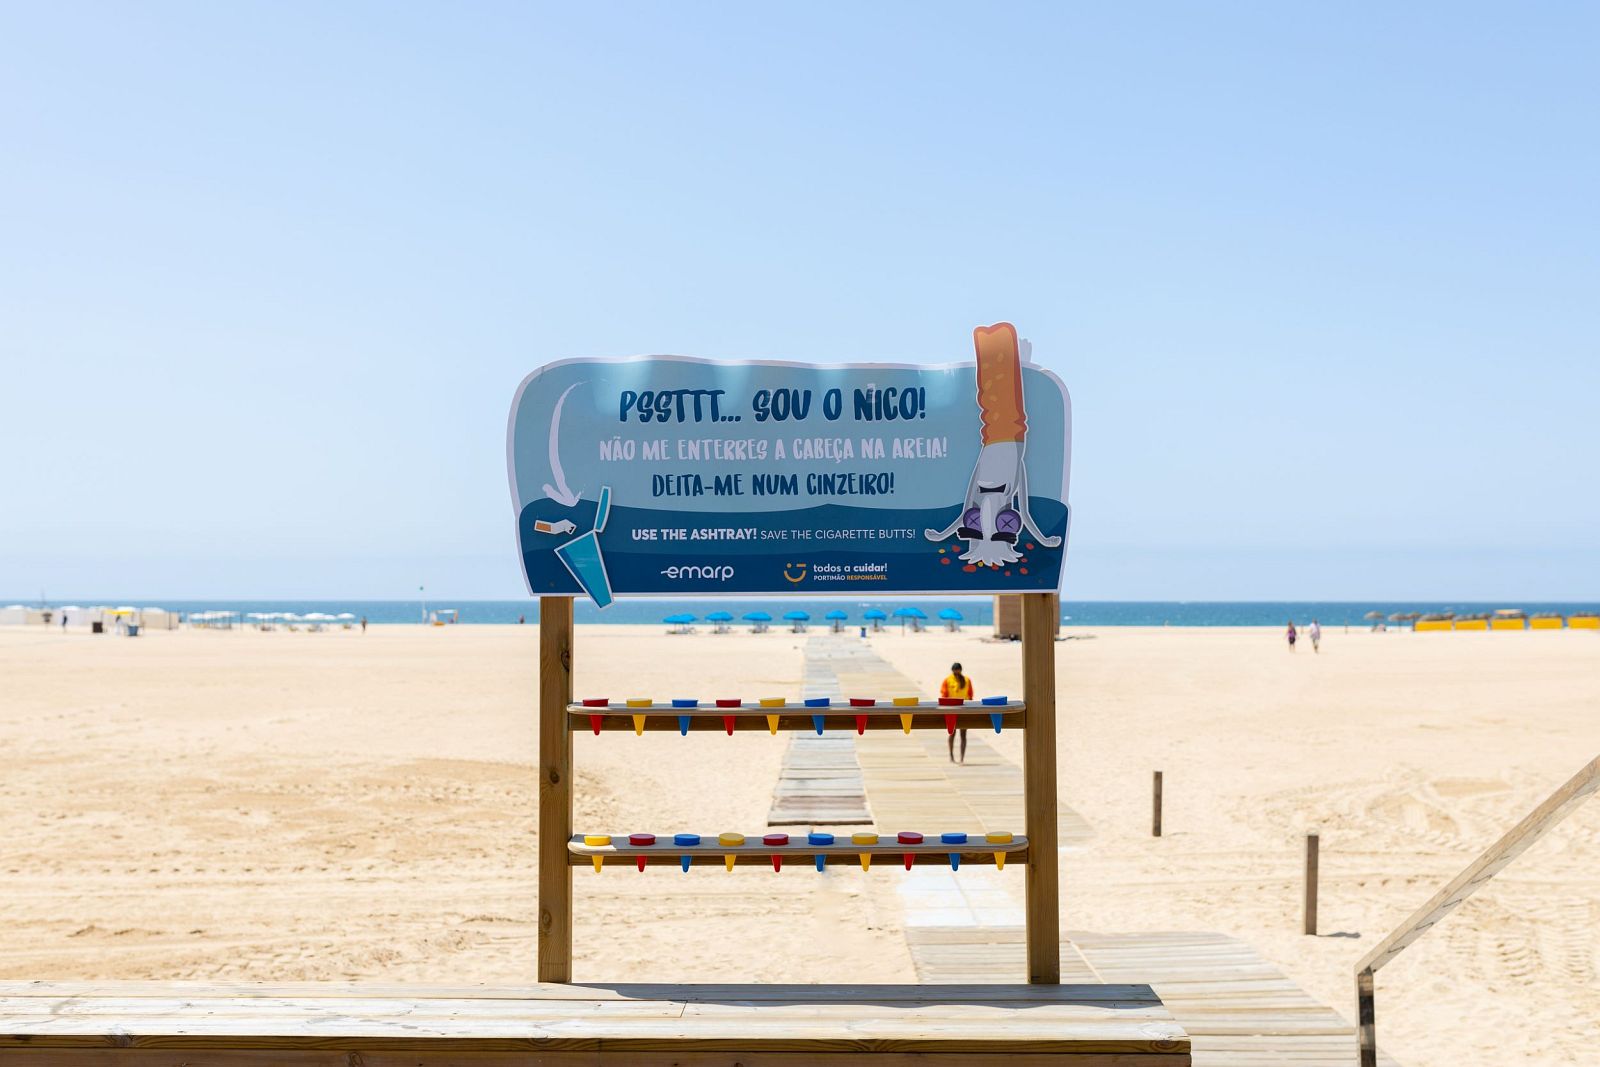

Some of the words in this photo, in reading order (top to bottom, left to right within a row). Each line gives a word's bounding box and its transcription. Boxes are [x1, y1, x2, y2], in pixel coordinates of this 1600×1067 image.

[752, 388, 812, 422] SOU
[822, 388, 843, 421] O
[853, 386, 926, 421] NICO!
[600, 435, 636, 461] NÃO
[642, 439, 671, 461] ME
[678, 438, 768, 461] ENTERRES
[774, 438, 786, 461] A
[792, 437, 854, 464] CABEÇA
[861, 437, 886, 460] NA
[892, 436, 948, 460] AREIA!
[652, 473, 745, 497] DEITA-ME
[752, 473, 799, 497] NUM
[806, 471, 895, 496] CINZEIRO!
[631, 529, 658, 540] USE
[661, 528, 688, 540] THE
[690, 527, 758, 540] ASHTRAY!
[760, 530, 788, 540] SAVE
[791, 529, 812, 540] THE
[815, 529, 876, 540] CIGARETTE
[878, 528, 916, 539] BUTTS!
[661, 565, 734, 581] emarp
[813, 563, 842, 573] todos
[853, 563, 888, 573] cuidar!
[813, 573, 846, 581] PORTIMÃO
[846, 573, 888, 581] RESPONSÁVEL
